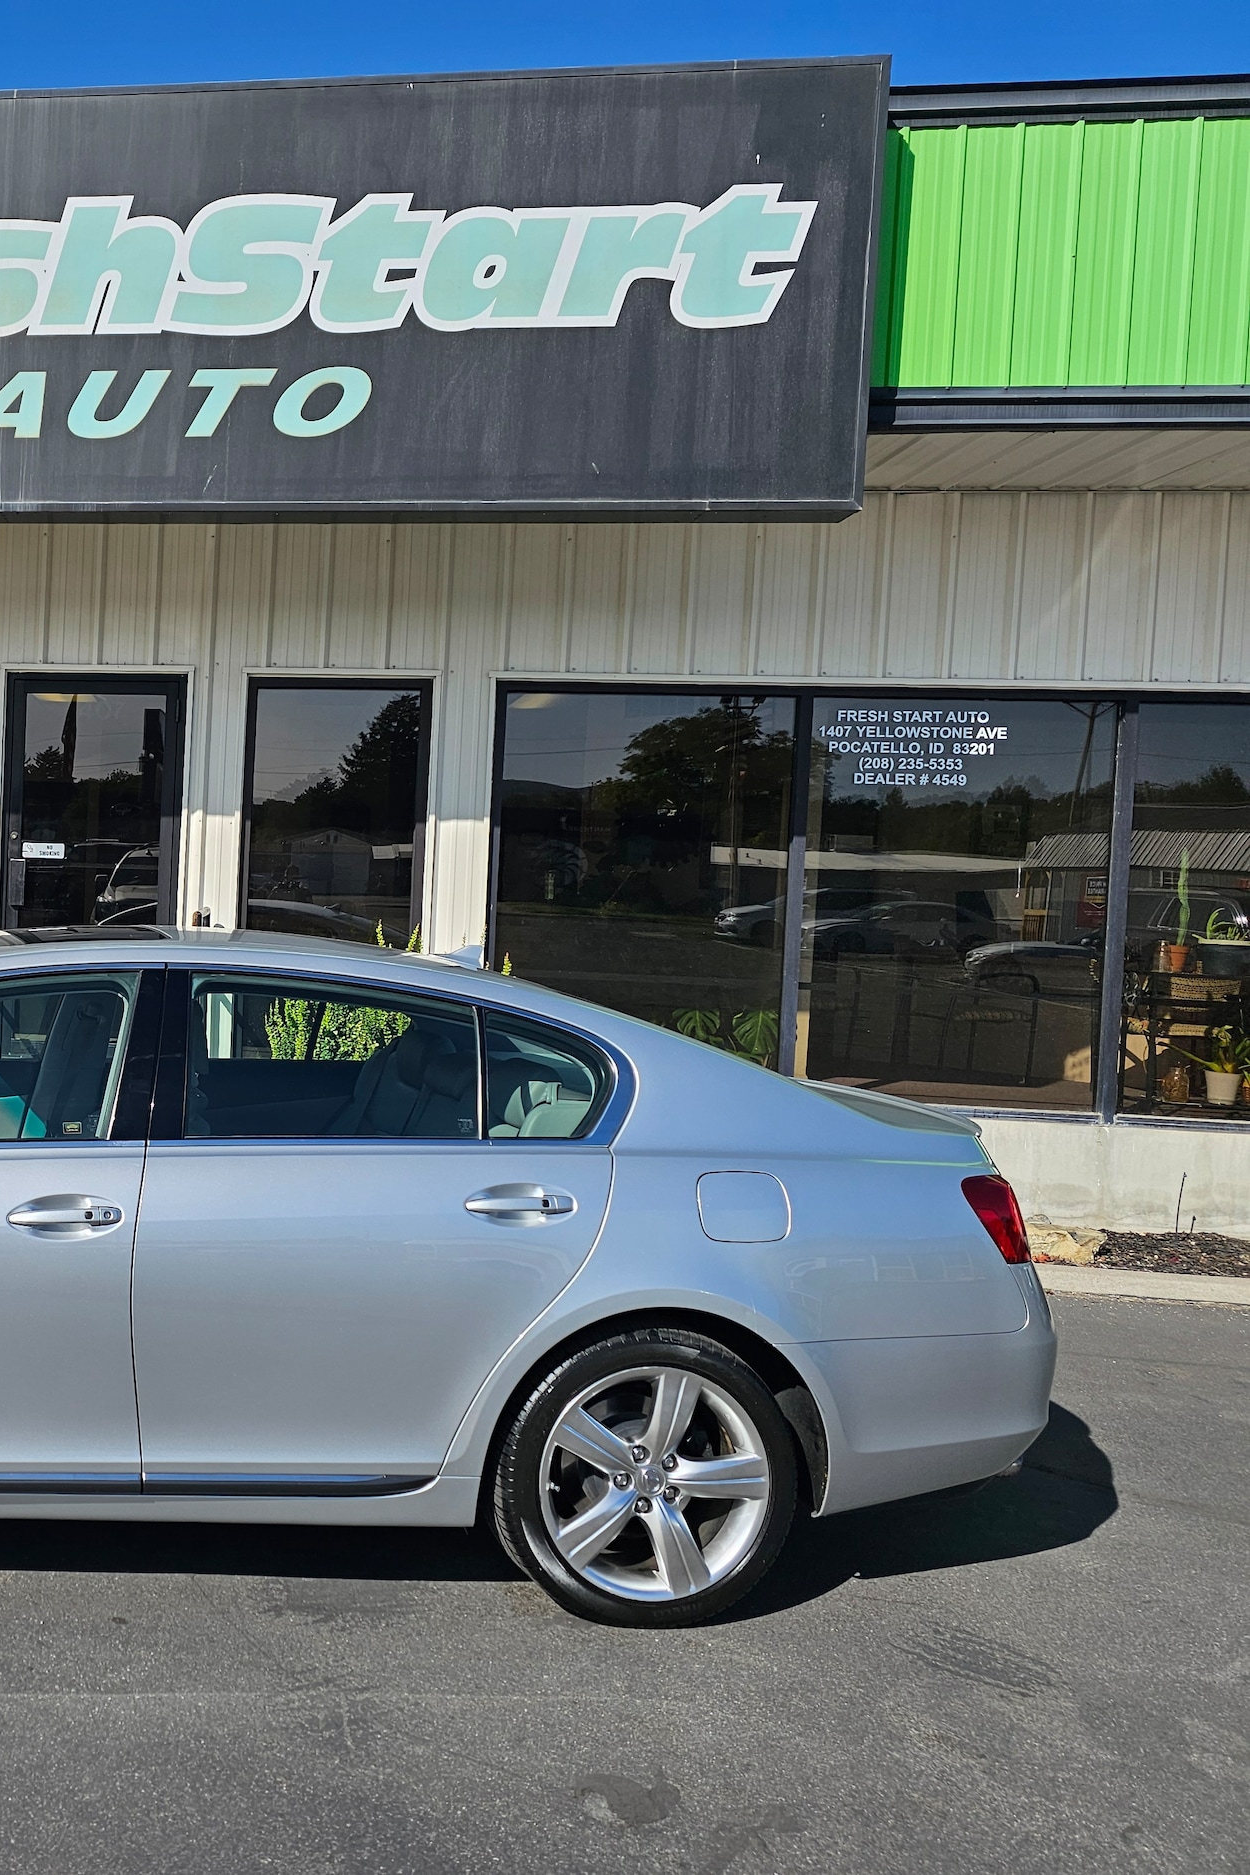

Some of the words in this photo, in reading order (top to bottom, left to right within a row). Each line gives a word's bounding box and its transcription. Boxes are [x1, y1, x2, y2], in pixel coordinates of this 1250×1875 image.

[837, 710, 888, 722] FRESH
[892, 710, 943, 723] START
[945, 711, 990, 723] AUTO
[819, 725, 852, 738] 1407
[855, 726, 973, 739] YELLOWSTONE
[975, 727, 1008, 740] AVE
[828, 741, 924, 756] POCATELLO,
[928, 742, 945, 754] ID
[952, 743, 995, 755] 83201
[858, 757, 895, 772] (208)
[897, 757, 963, 770] 235-5353
[853, 772, 916, 785] DEALER
[919, 773, 930, 786] #
[931, 773, 967, 786] 4549
